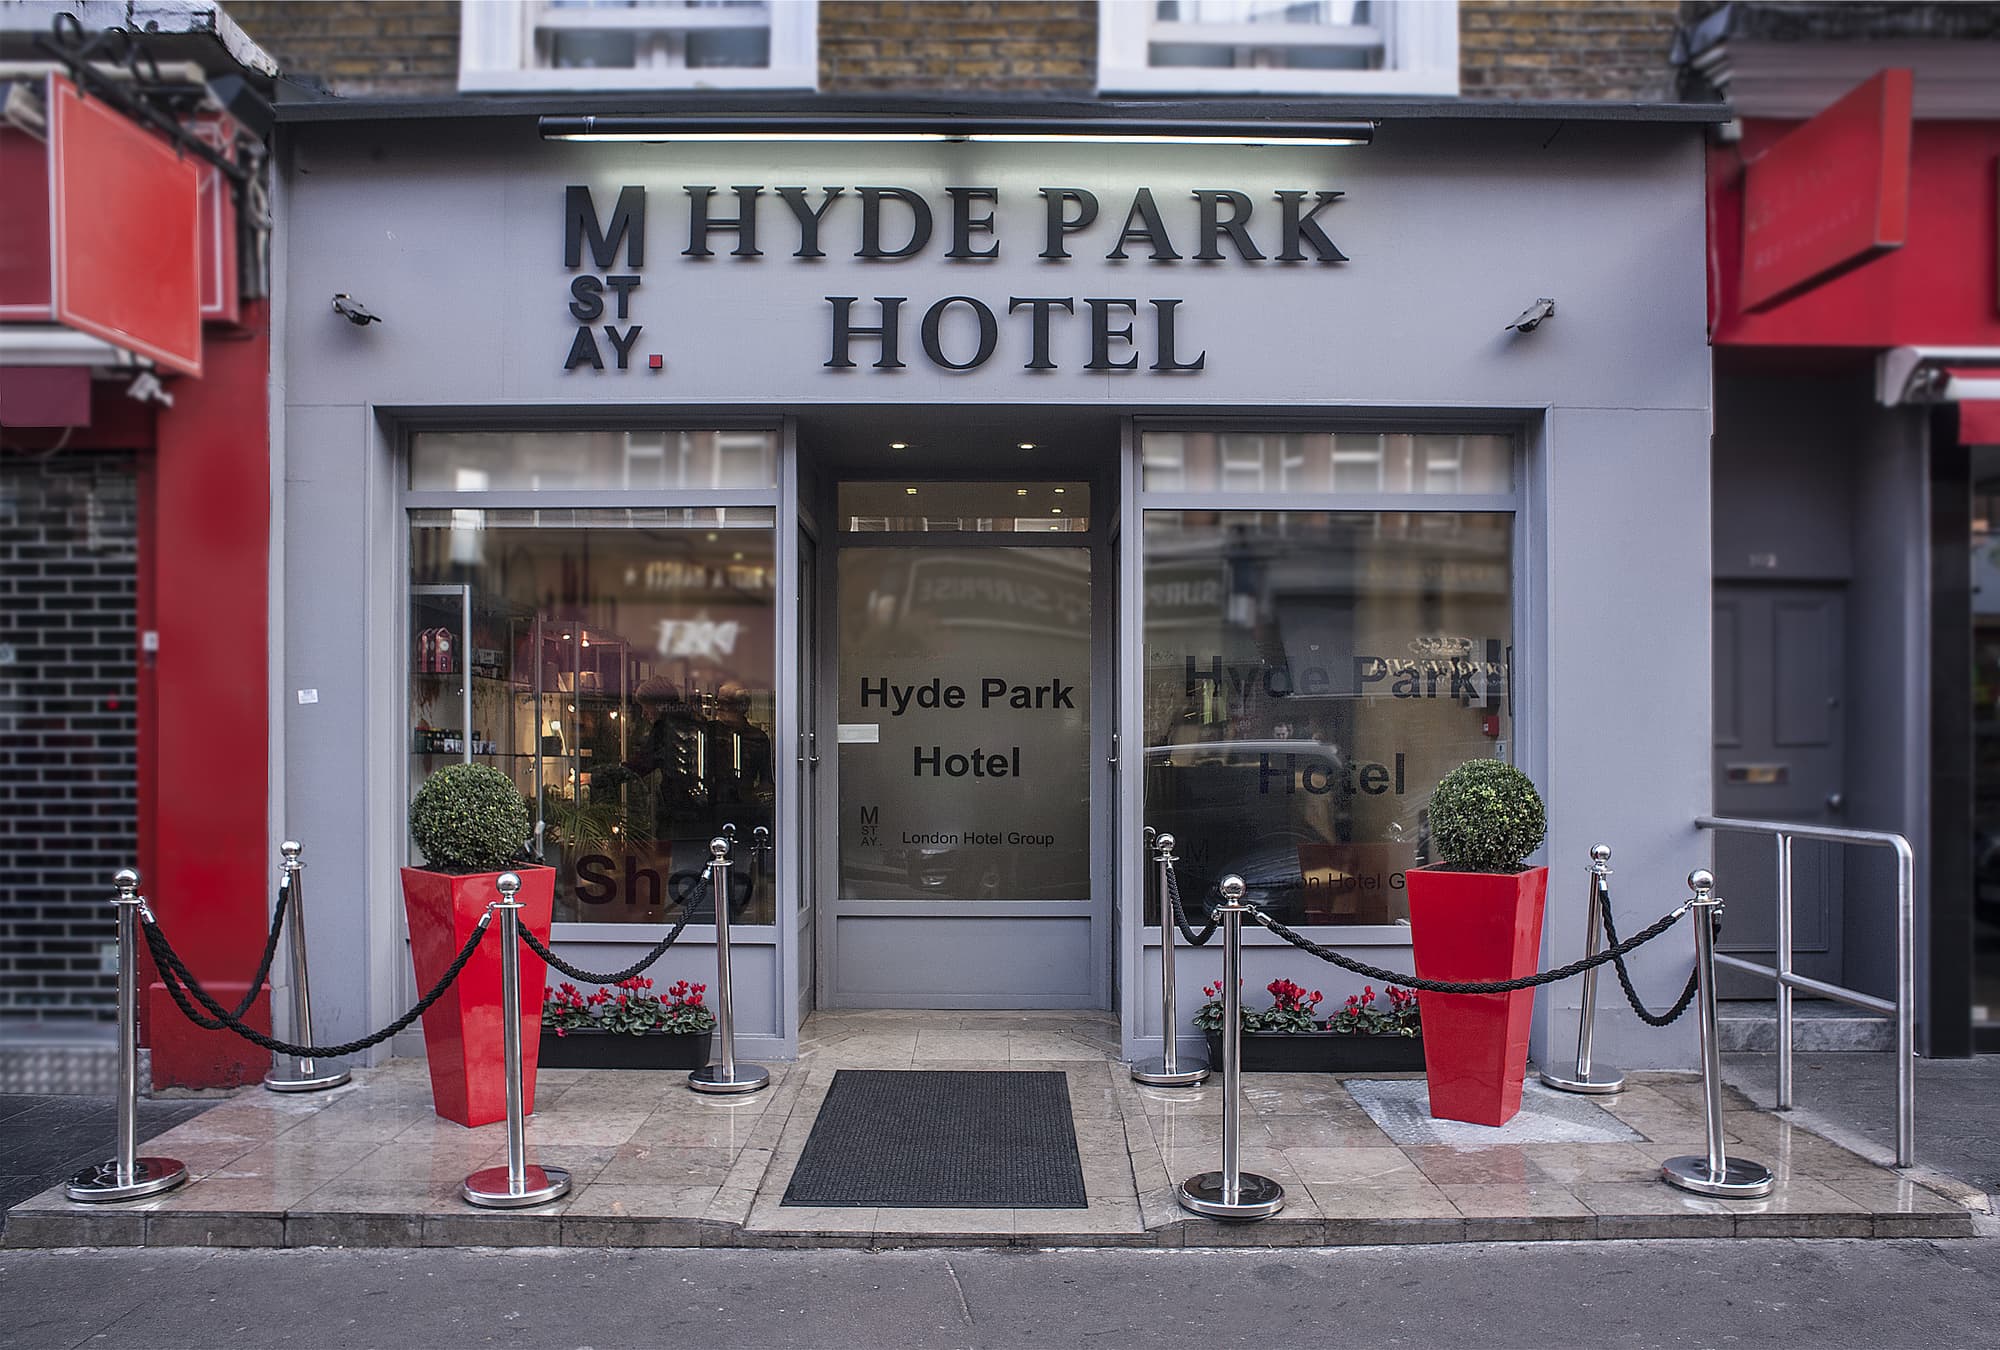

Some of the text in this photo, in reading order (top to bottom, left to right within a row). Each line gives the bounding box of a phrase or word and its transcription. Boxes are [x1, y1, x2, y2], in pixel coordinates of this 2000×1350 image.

[565, 185, 645, 267] M
[681, 185, 1350, 262] HYDE PARK
[569, 275, 641, 321] ST
[823, 295, 1206, 370] HOTEL
[861, 677, 1075, 716] Hyde Park
[1353, 656, 1480, 699] Park
[914, 746, 1020, 777] Hotel
[1260, 752, 1405, 795] Hotel
[860, 806, 879, 824] M
[861, 826, 877, 835] ST
[902, 831, 1055, 849] London Hotel Group
[1328, 873, 1384, 889] Hotel
